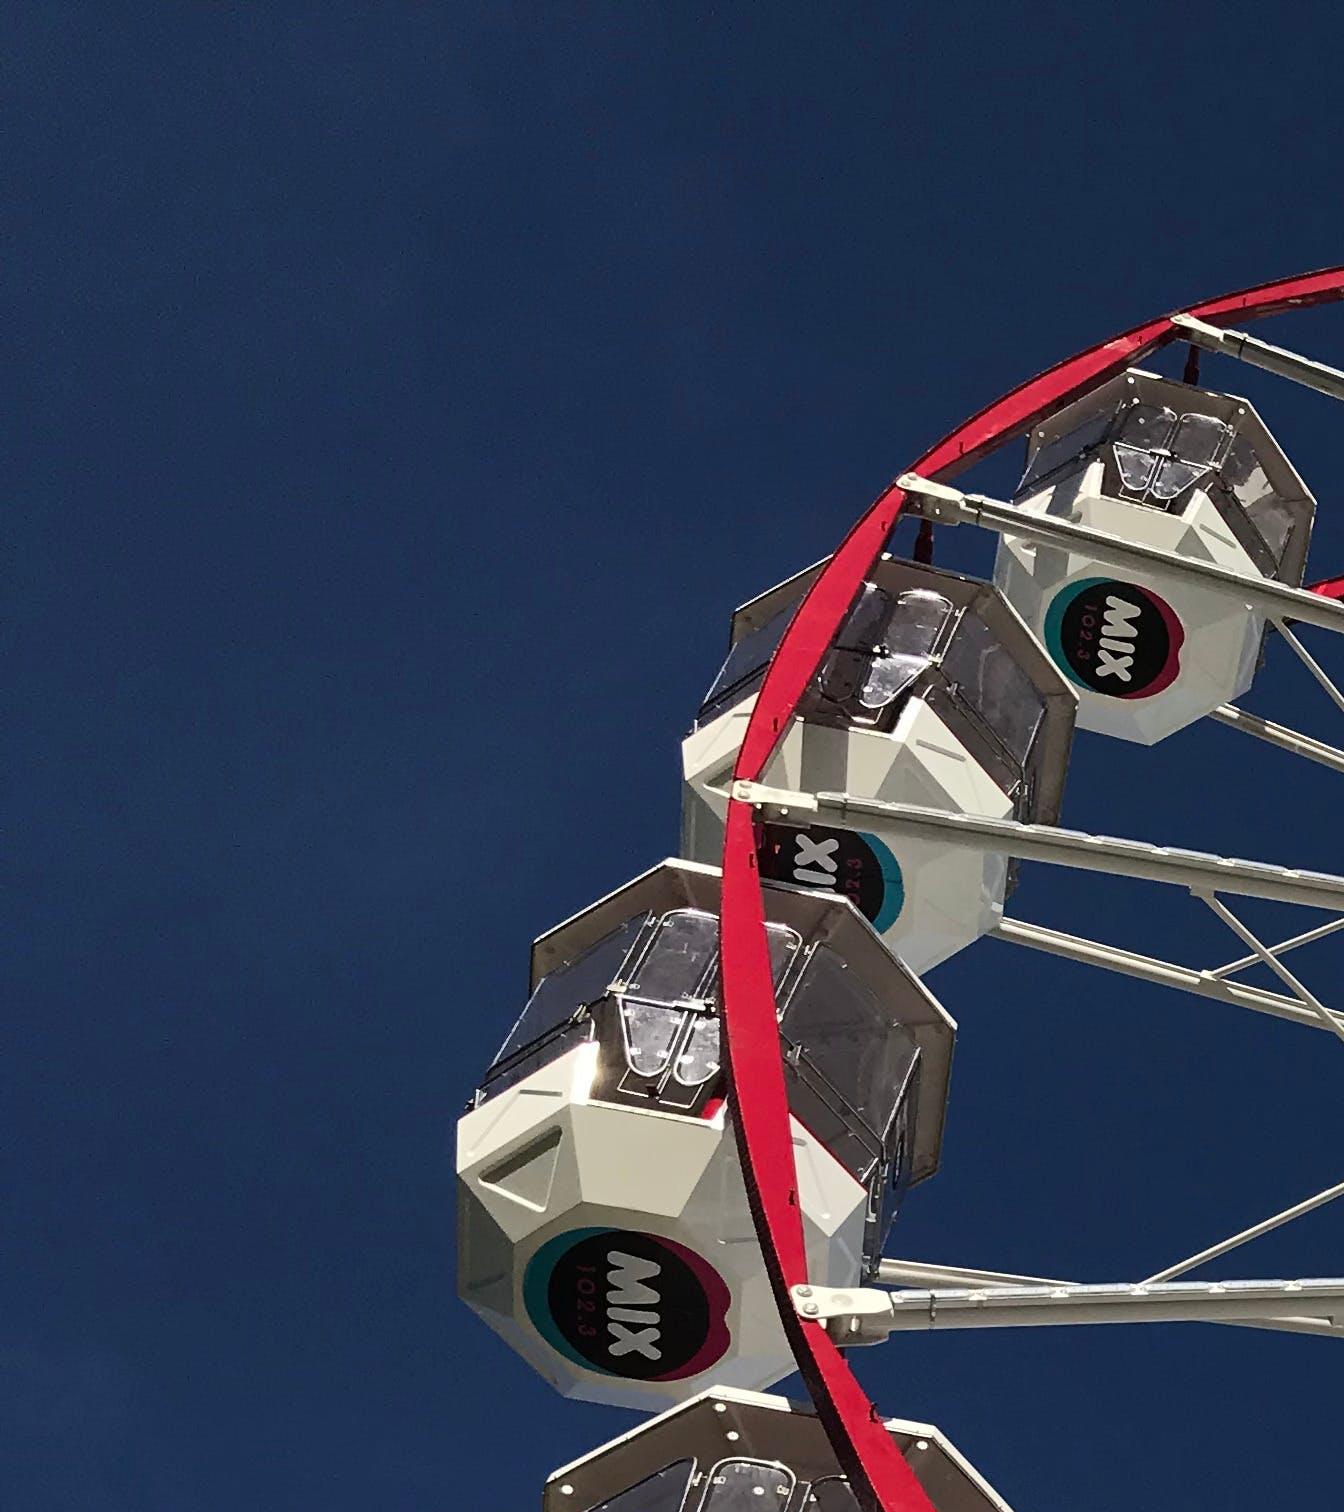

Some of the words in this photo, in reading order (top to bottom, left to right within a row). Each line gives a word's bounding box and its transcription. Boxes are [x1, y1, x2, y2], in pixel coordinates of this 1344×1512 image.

[1077, 604, 1098, 660] 102.3
[1095, 595, 1142, 682] MIX
[793, 833, 840, 893] IX
[845, 857, 863, 905] 02.3
[576, 1265, 597, 1337] 102.3
[606, 1250, 662, 1361] MIX
